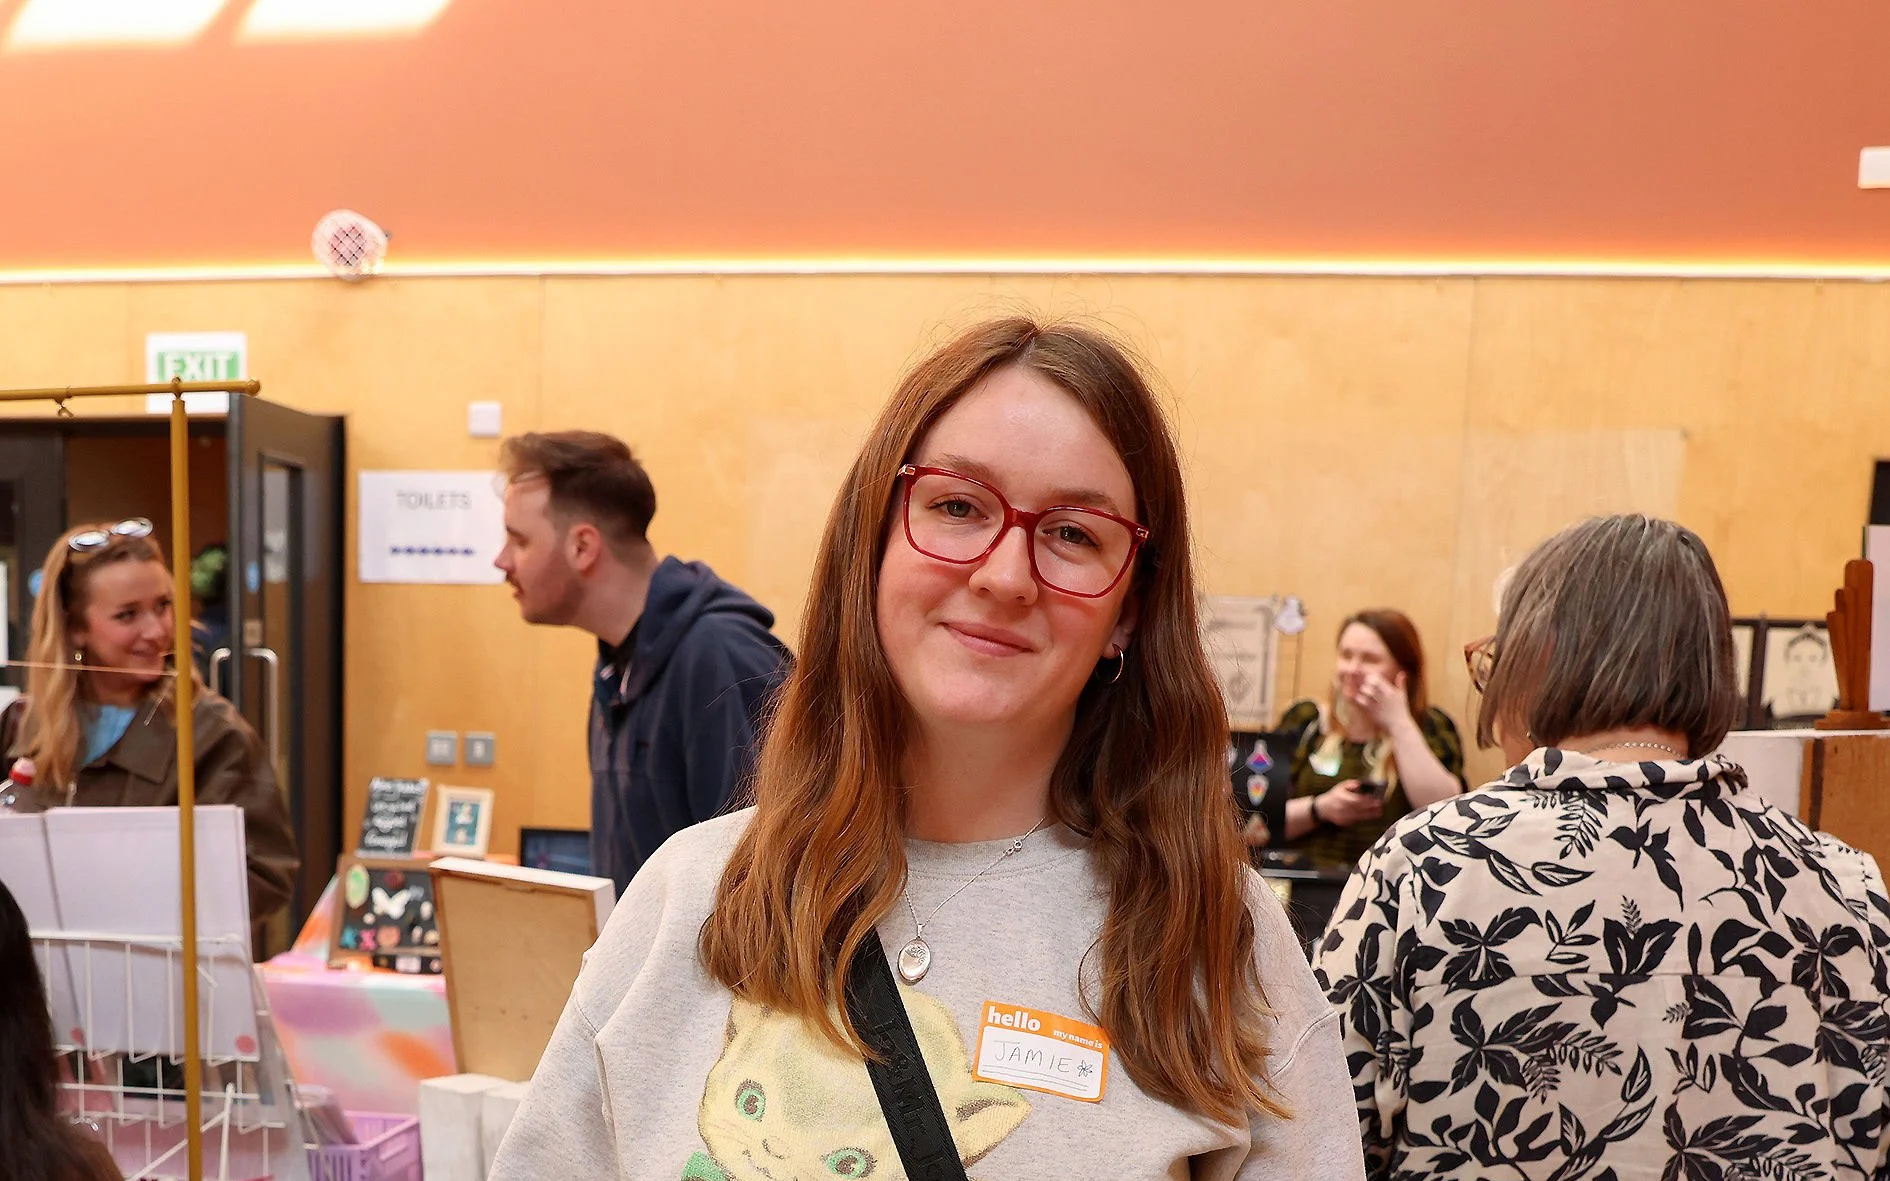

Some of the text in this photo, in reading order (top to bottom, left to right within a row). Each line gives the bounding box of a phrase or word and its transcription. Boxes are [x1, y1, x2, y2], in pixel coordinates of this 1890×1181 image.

[163, 351, 233, 382] EXIT
[396, 490, 472, 510] TOILETS
[987, 1005, 1041, 1032] hello
[1053, 1029, 1103, 1049] my name is
[994, 1039, 1073, 1073] JAMIE
